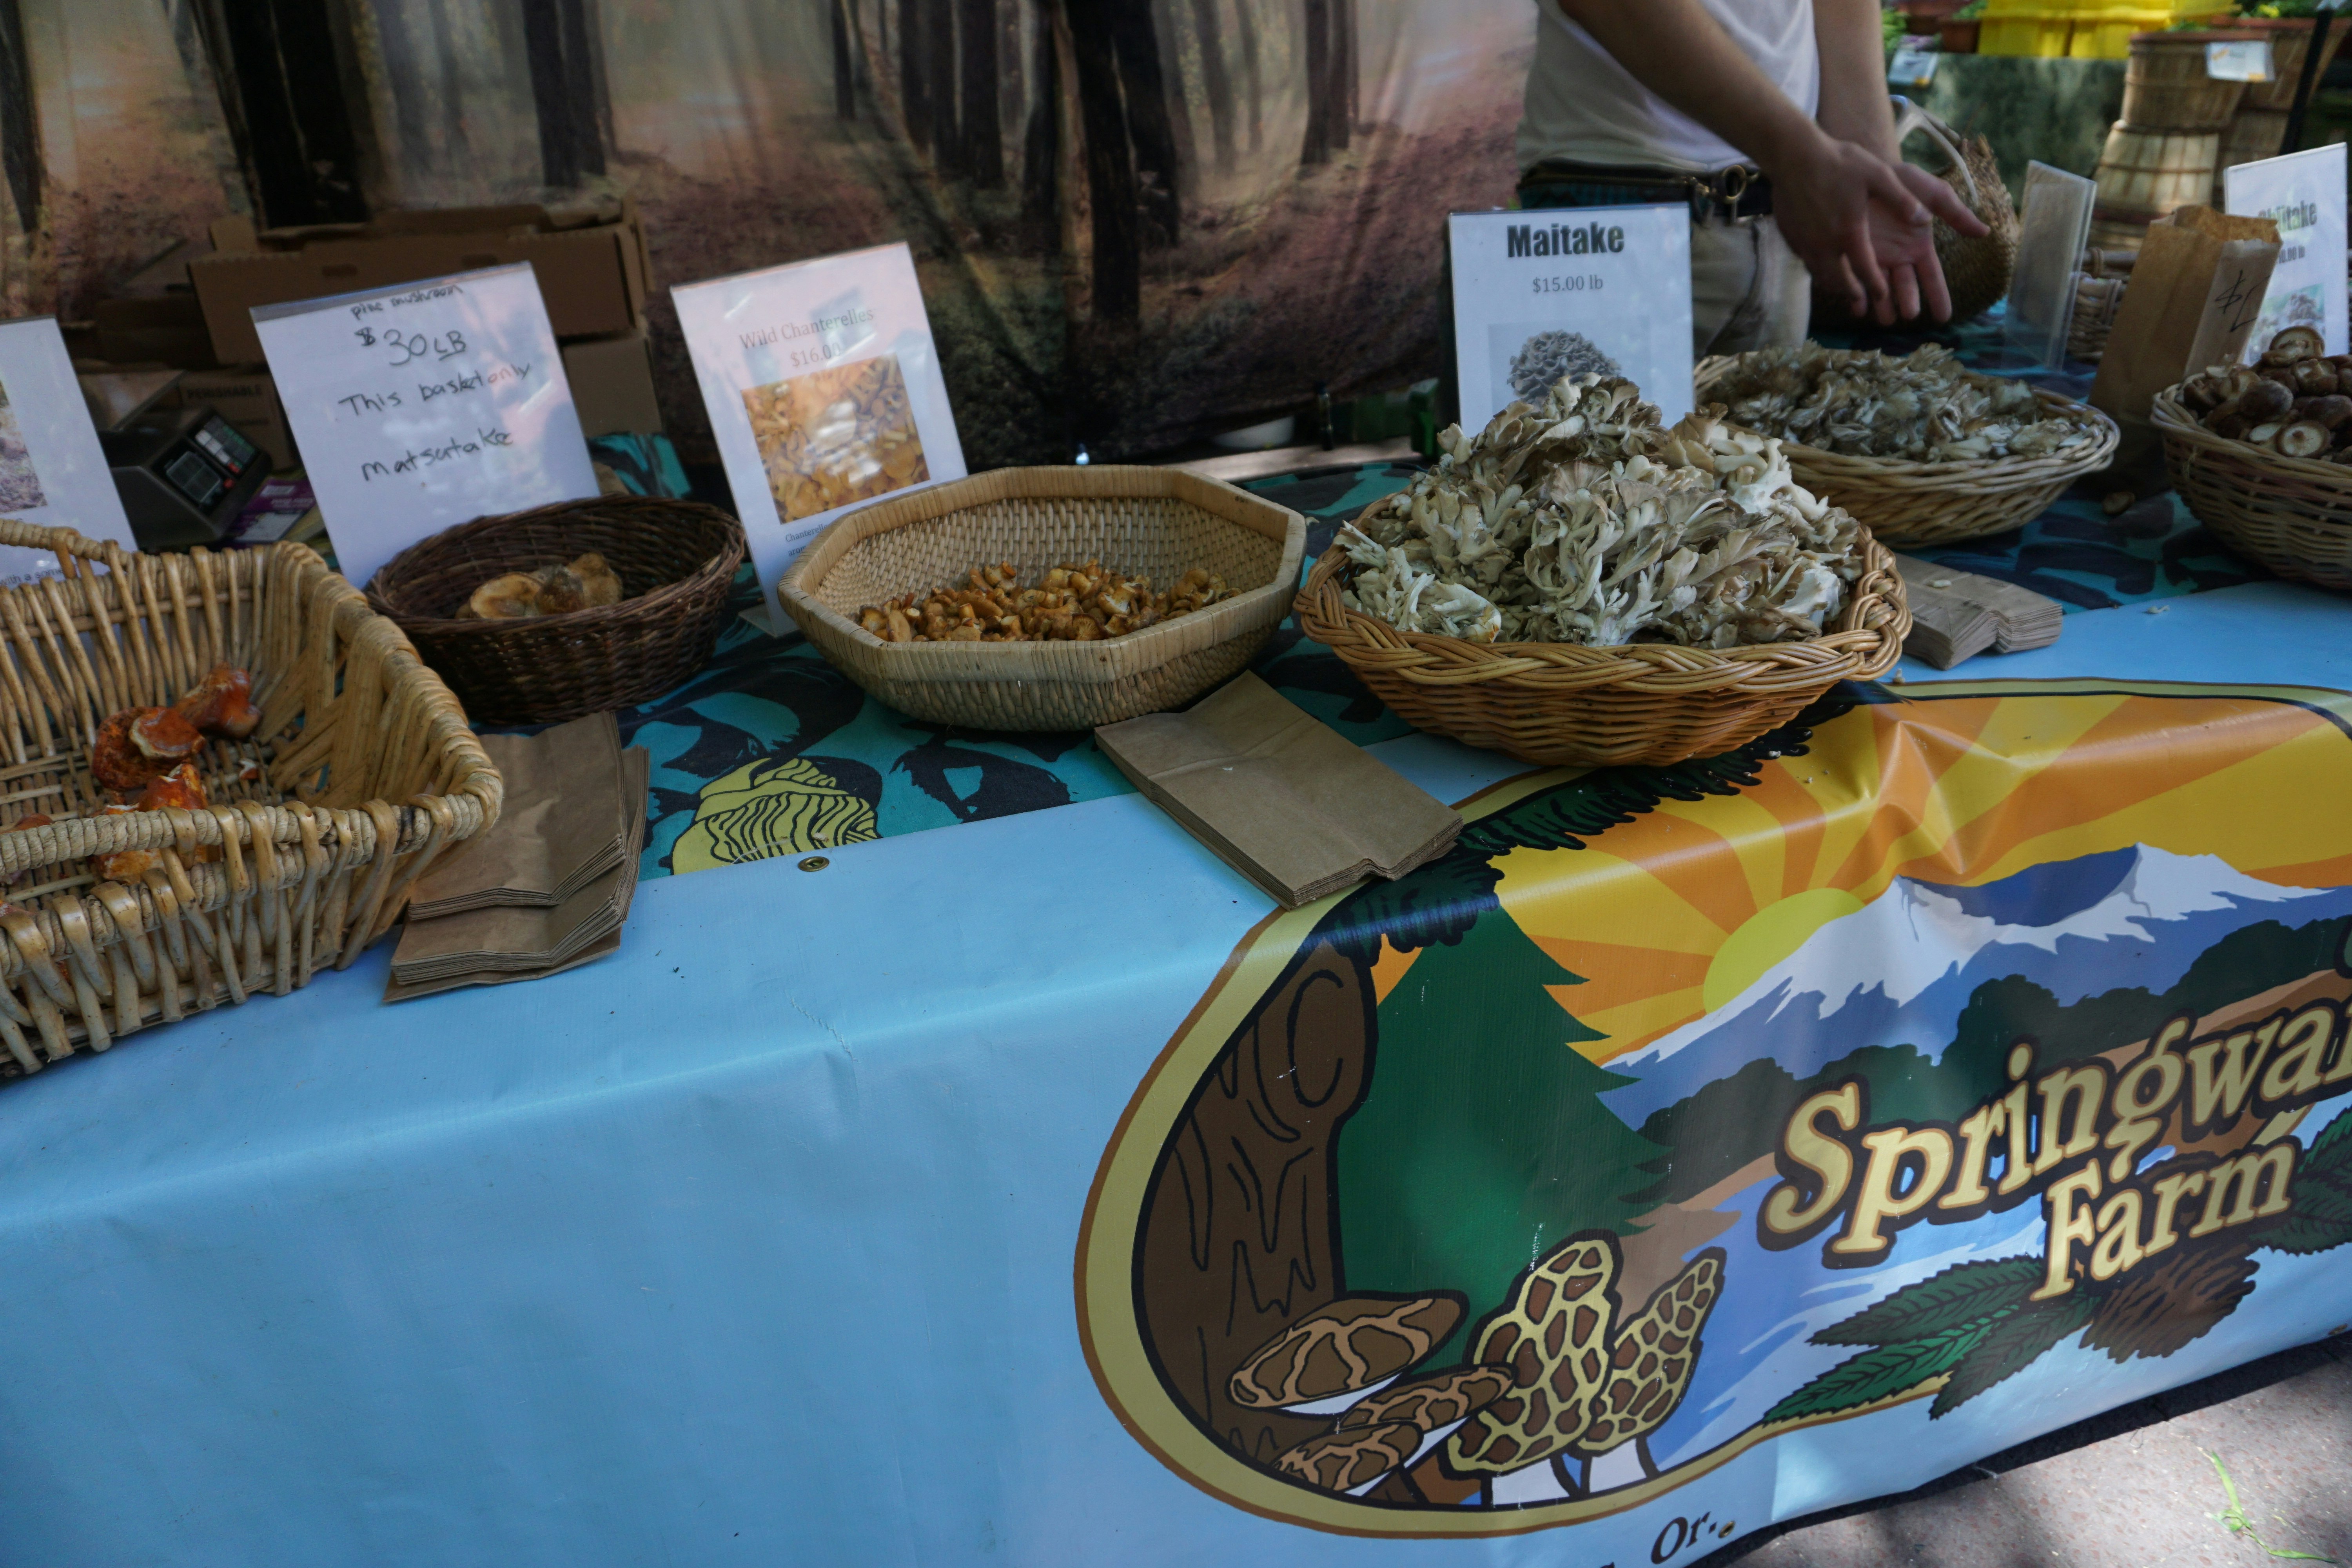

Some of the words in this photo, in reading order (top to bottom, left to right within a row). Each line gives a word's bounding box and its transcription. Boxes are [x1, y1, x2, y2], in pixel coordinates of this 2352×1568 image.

[1507, 221, 1625, 258] Maitake
[1532, 275, 1585, 293] $15.00
[1589, 274, 1603, 289] lb
[350, 301, 383, 320] pine
[390, 285, 464, 307] mushroom
[739, 327, 779, 349] Wild
[781, 309, 874, 340] Chanterelles
[789, 341, 842, 368] $16.00
[338, 392, 402, 416] This
[418, 370, 484, 401] basket
[487, 363, 530, 383] only
[2030, 1142, 2296, 1301] Farm
